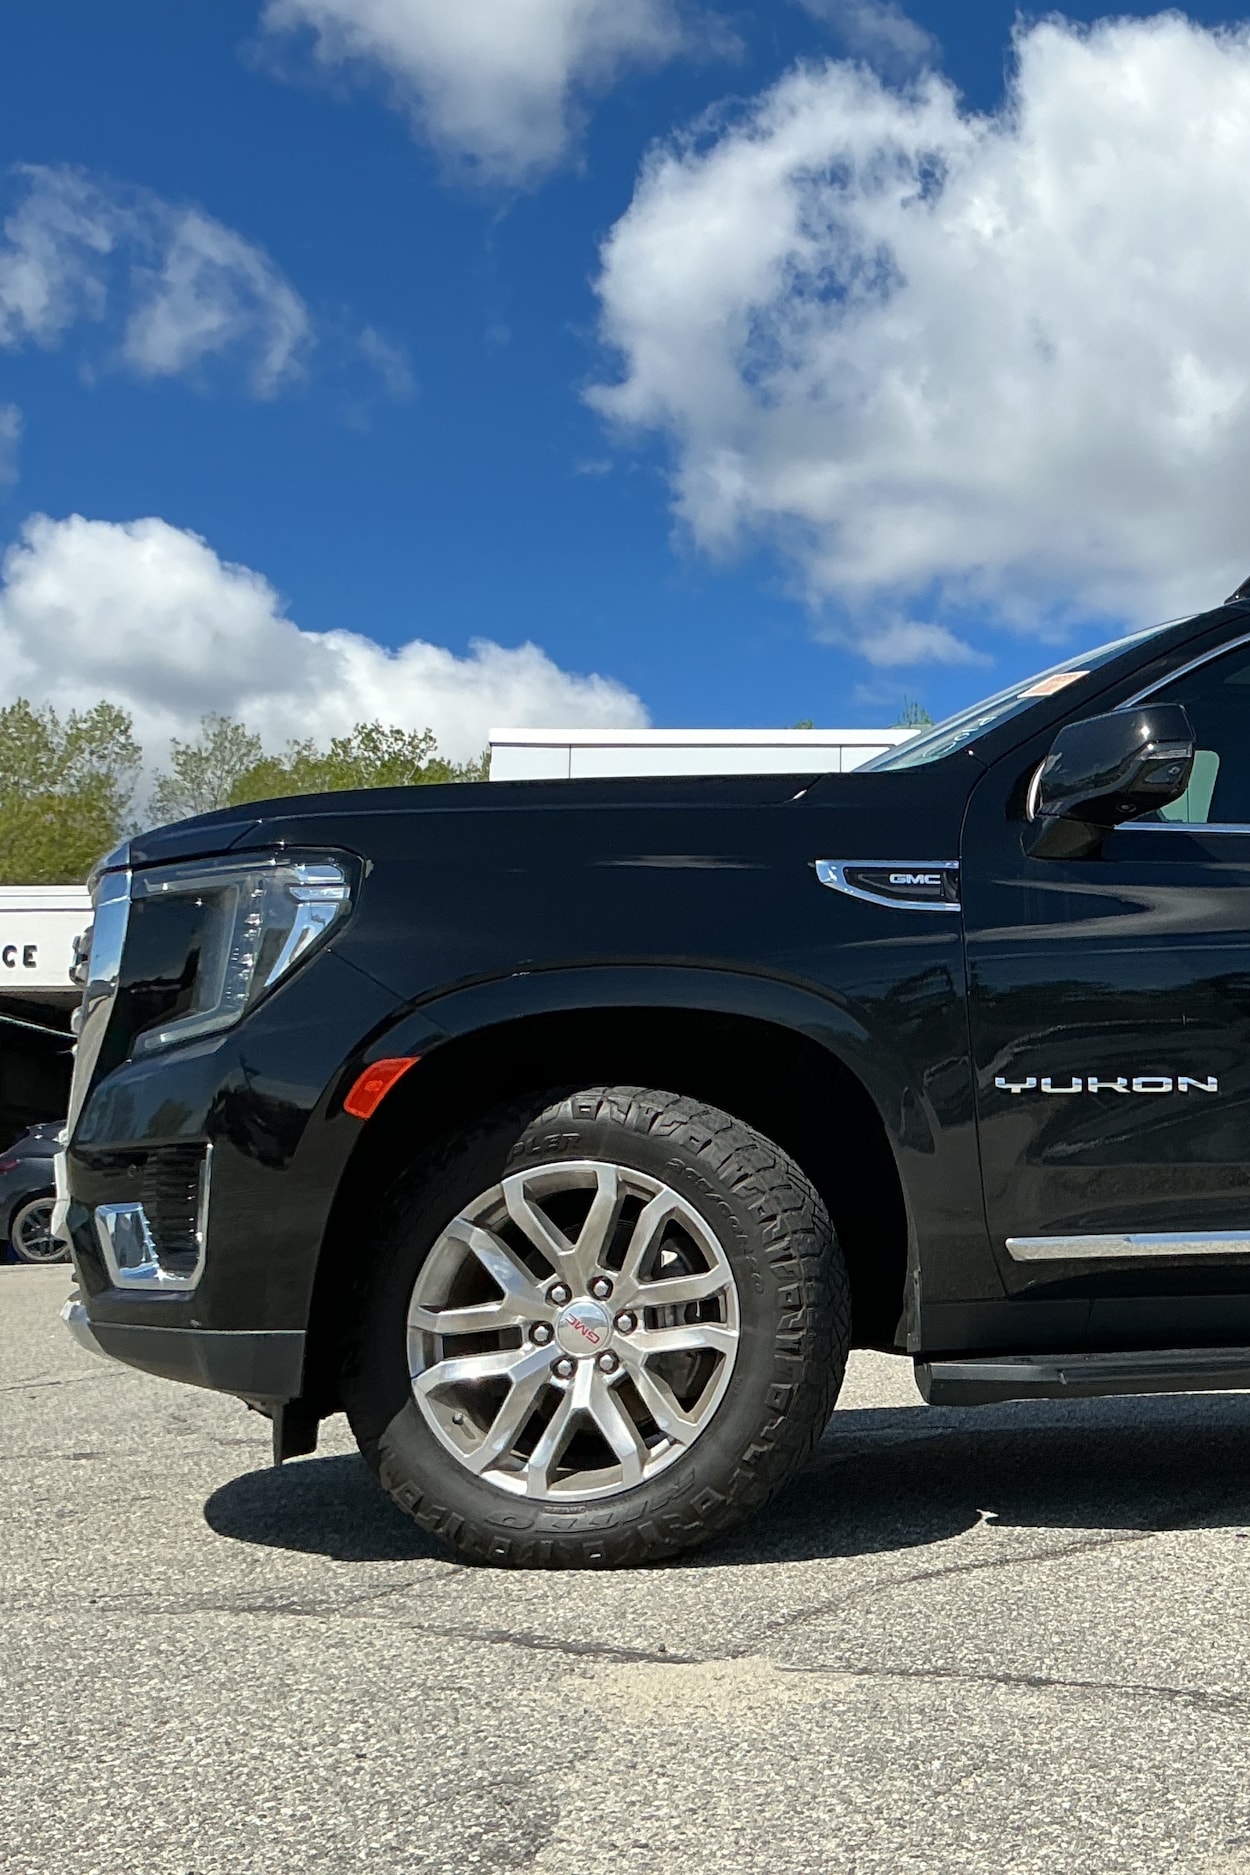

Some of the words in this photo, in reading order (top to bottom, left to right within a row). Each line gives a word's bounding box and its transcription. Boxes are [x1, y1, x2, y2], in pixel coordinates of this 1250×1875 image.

[889, 873, 941, 885] GMC
[994, 1076, 1218, 1094] YUKON
[564, 1312, 601, 1345] GMC
